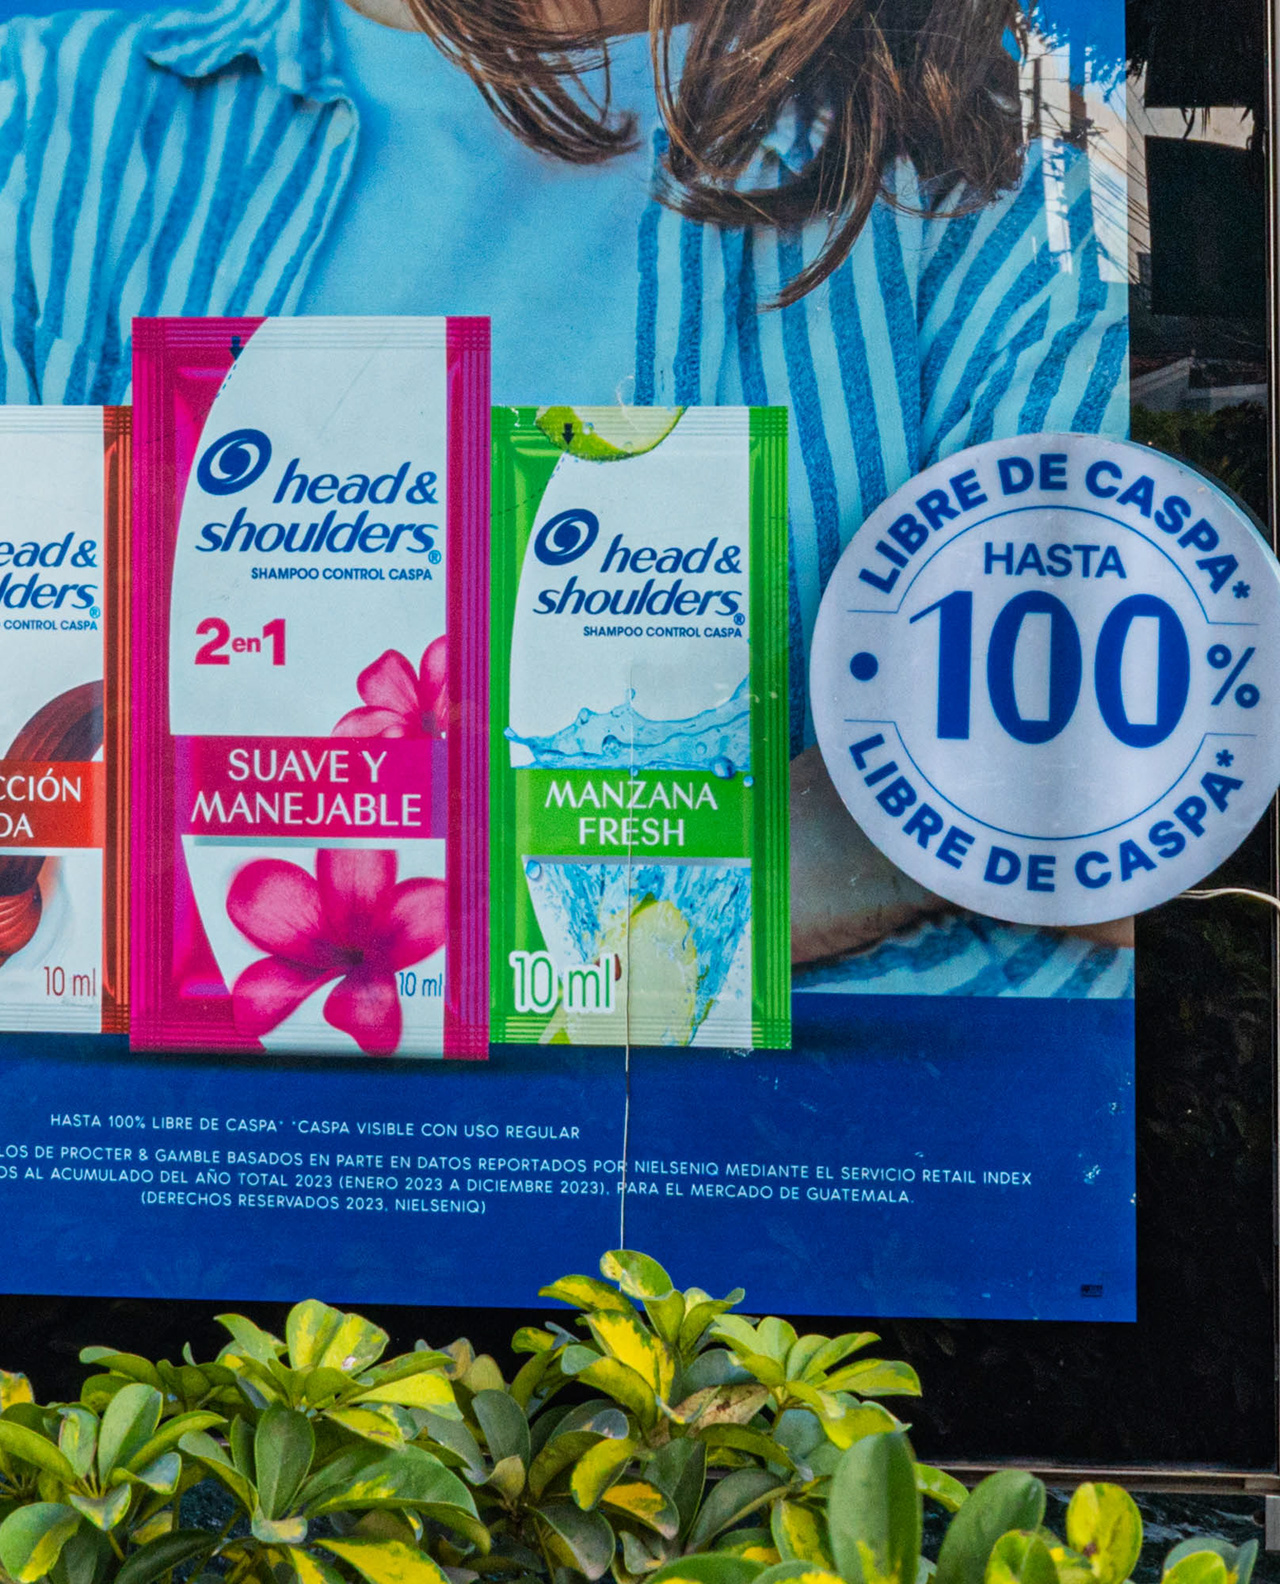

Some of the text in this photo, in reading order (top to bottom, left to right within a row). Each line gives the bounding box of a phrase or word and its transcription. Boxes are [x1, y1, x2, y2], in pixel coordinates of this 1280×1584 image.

[858, 469, 988, 594] LIBRE
[997, 453, 1068, 496] DE
[251, 567, 433, 581] SHAMPOO CONTROL CASPA
[984, 542, 1127, 579] HASTA
[3, 620, 58, 631] CONTROL
[60, 620, 98, 631] CASPA
[583, 626, 742, 638] SHAMPOO CONTROL CASPA
[228, 748, 387, 783] SUAVE Y
[190, 791, 422, 827] MANEJABLE
[544, 780, 719, 810] MANZANA
[848, 733, 976, 870] LIBRE
[983, 846, 1056, 892] DE
[579, 817, 685, 846] FRESH
[43, 966, 96, 996] 10 ml
[399, 971, 442, 997] 10 ml
[509, 950, 616, 1014] 10 ml
[51, 1115, 101, 1128] HASTA
[109, 1116, 146, 1129] 100%
[152, 1117, 193, 1130] LIBRE
[200, 1118, 219, 1131] DE
[357, 1122, 414, 1136] VISIBLE
[421, 1123, 457, 1137] CON
[464, 1124, 499, 1138] USO
[506, 1125, 580, 1139] REGULAR
[35, 1145, 54, 1159] DE
[61, 1146, 132, 1161] PROCTER
[139, 1148, 148, 1161] &
[155, 1148, 220, 1163] GAMBLE
[227, 1151, 303, 1166] BASADOS
[310, 1154, 330, 1166] EN
[336, 1155, 384, 1168] PARTE
[391, 1156, 411, 1169] EN
[418, 1157, 471, 1170] DATOS
[479, 1158, 587, 1172] REPORTADOS
[594, 1160, 627, 1173] POR
[635, 1160, 718, 1176] NIELSENIQ
[726, 1163, 809, 1178] MEDIANTE
[816, 1166, 834, 1179] EL
[841, 1166, 915, 1182] SERVICIO
[922, 1169, 975, 1184] RETAIL
[983, 1171, 1032, 1186] INDEX
[24, 1167, 44, 1180] AL
[50, 1167, 154, 1183] ACUMULADO
[160, 1170, 188, 1184] DEL
[195, 1168, 231, 1185] AÑO
[238, 1172, 288, 1187] TOTAL
[295, 1174, 333, 1188] 2023
[338, 1176, 399, 1190] (ENERO
[405, 1177, 443, 1191] 2023
[449, 1179, 460, 1191] A
[467, 1179, 553, 1194] DICIEMBRE
[617, 1182, 659, 1195] PARA
[666, 1183, 684, 1196] EL
[691, 1183, 773, 1199] MERCADO
[780, 1187, 800, 1199] DE
[141, 1191, 232, 1207] (DERECHOS
[239, 1193, 340, 1209] RESERVADOS
[395, 1199, 487, 1214] NIELSENIQ)
